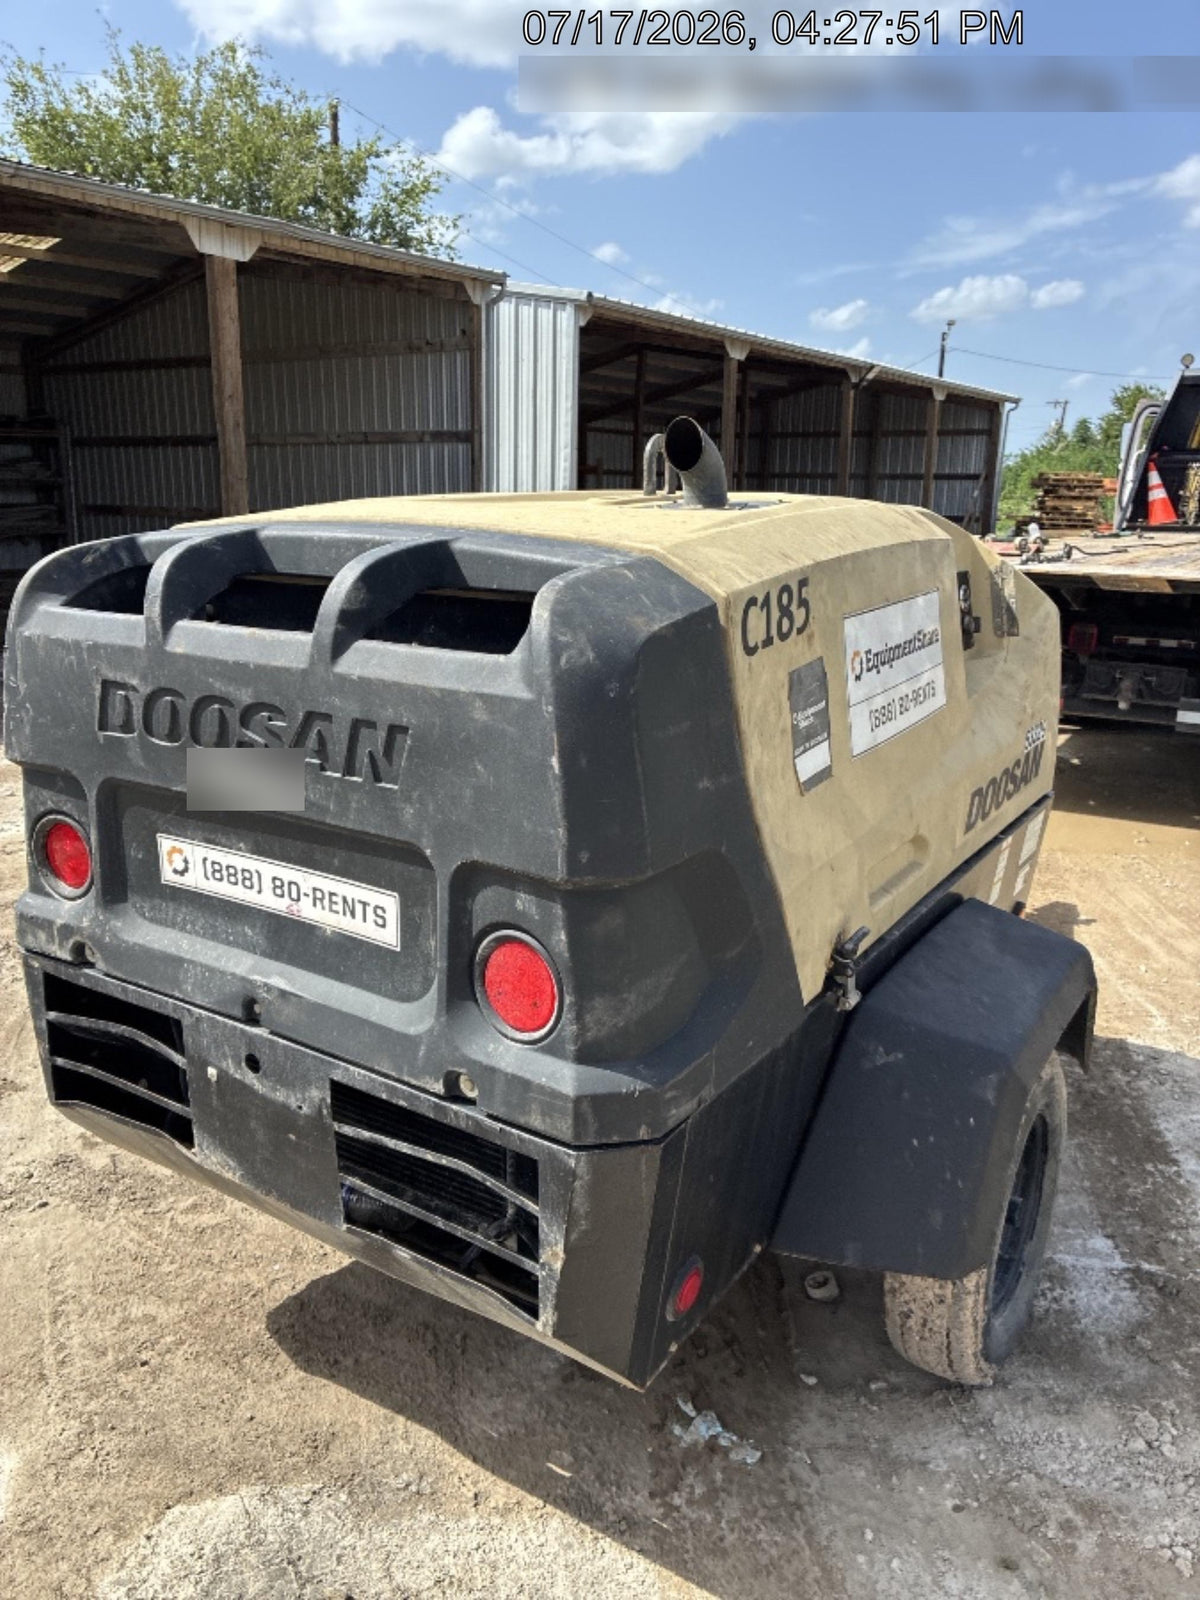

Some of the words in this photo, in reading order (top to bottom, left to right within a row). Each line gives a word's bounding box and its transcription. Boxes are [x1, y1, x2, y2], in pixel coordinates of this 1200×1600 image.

[740, 576, 811, 657] C185
[864, 627, 940, 674] EquipmentShare
[97, 677, 410, 789] DOOSAN
[964, 740, 1045, 835] DOOSAN
[202, 856, 263, 894] (888)
[271, 876, 388, 929] 80-RENTS
